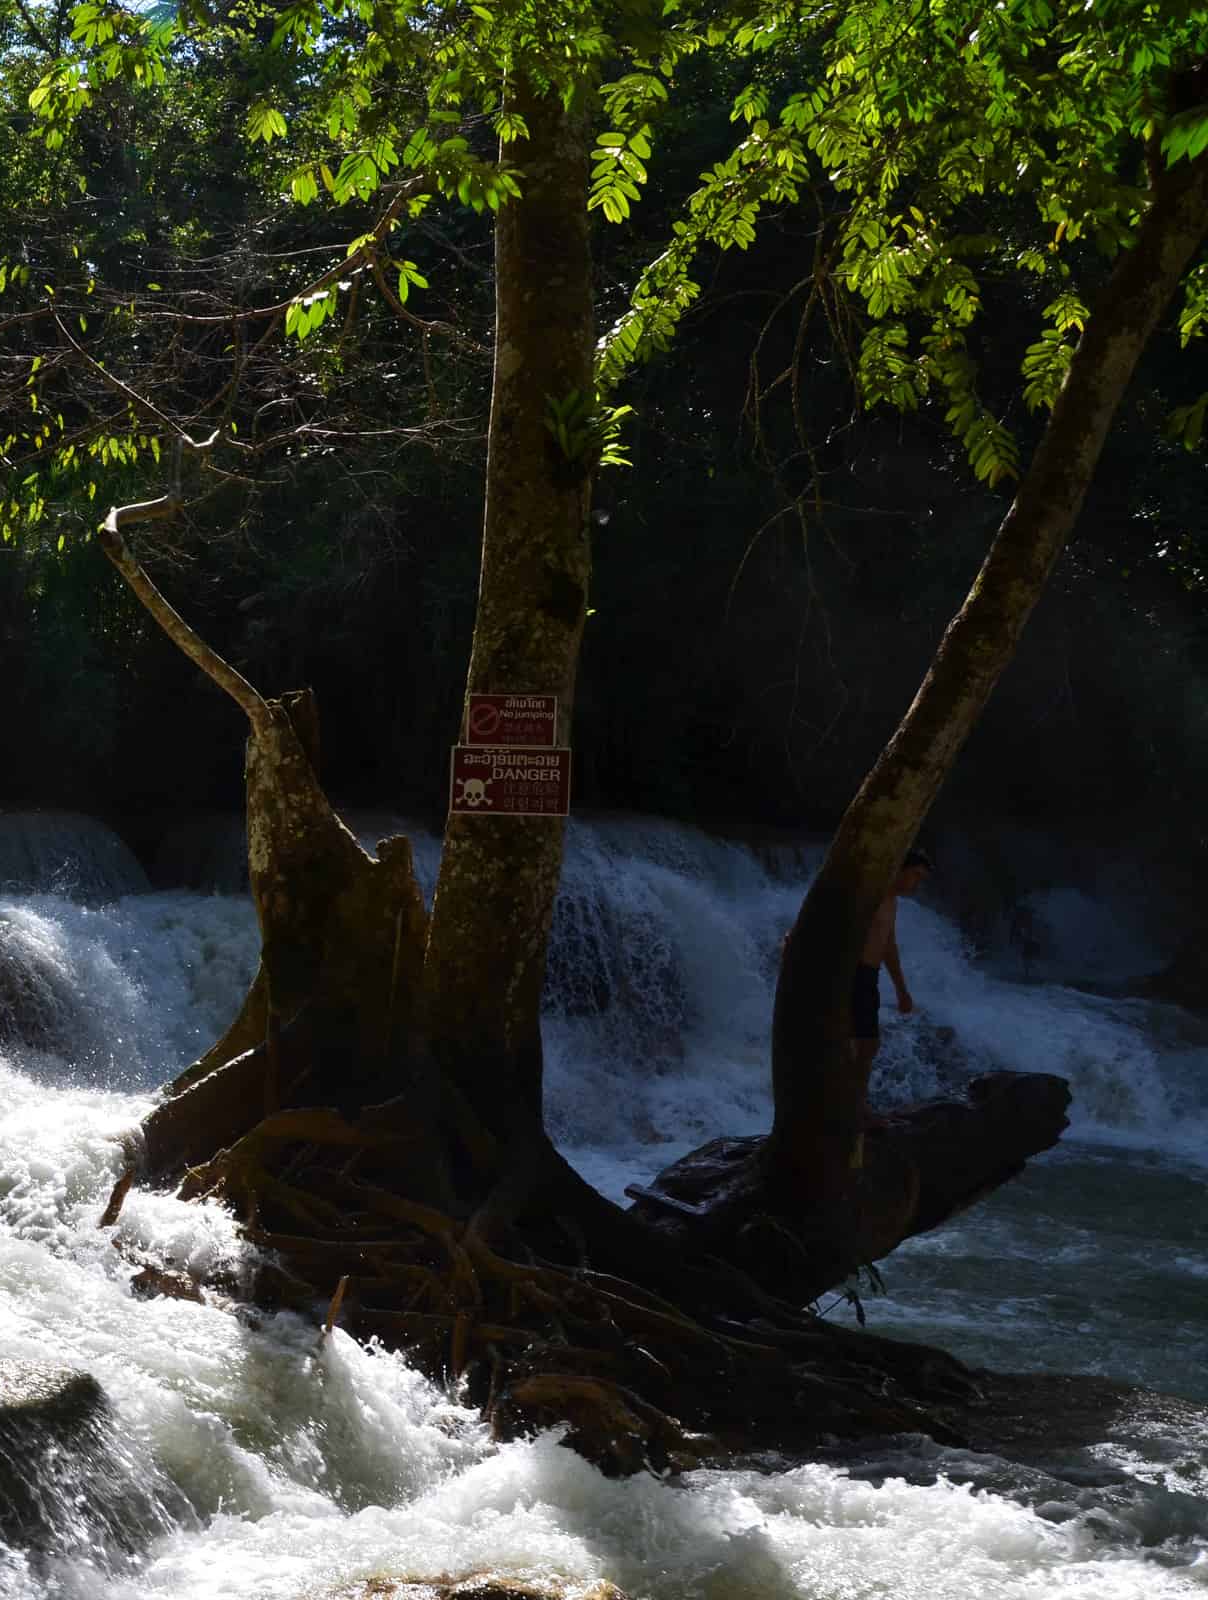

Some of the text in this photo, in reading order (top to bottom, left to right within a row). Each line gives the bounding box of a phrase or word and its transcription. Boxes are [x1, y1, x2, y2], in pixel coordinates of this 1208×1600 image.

[499, 709, 554, 721] No jumping
[492, 768, 561, 781] DANGER
